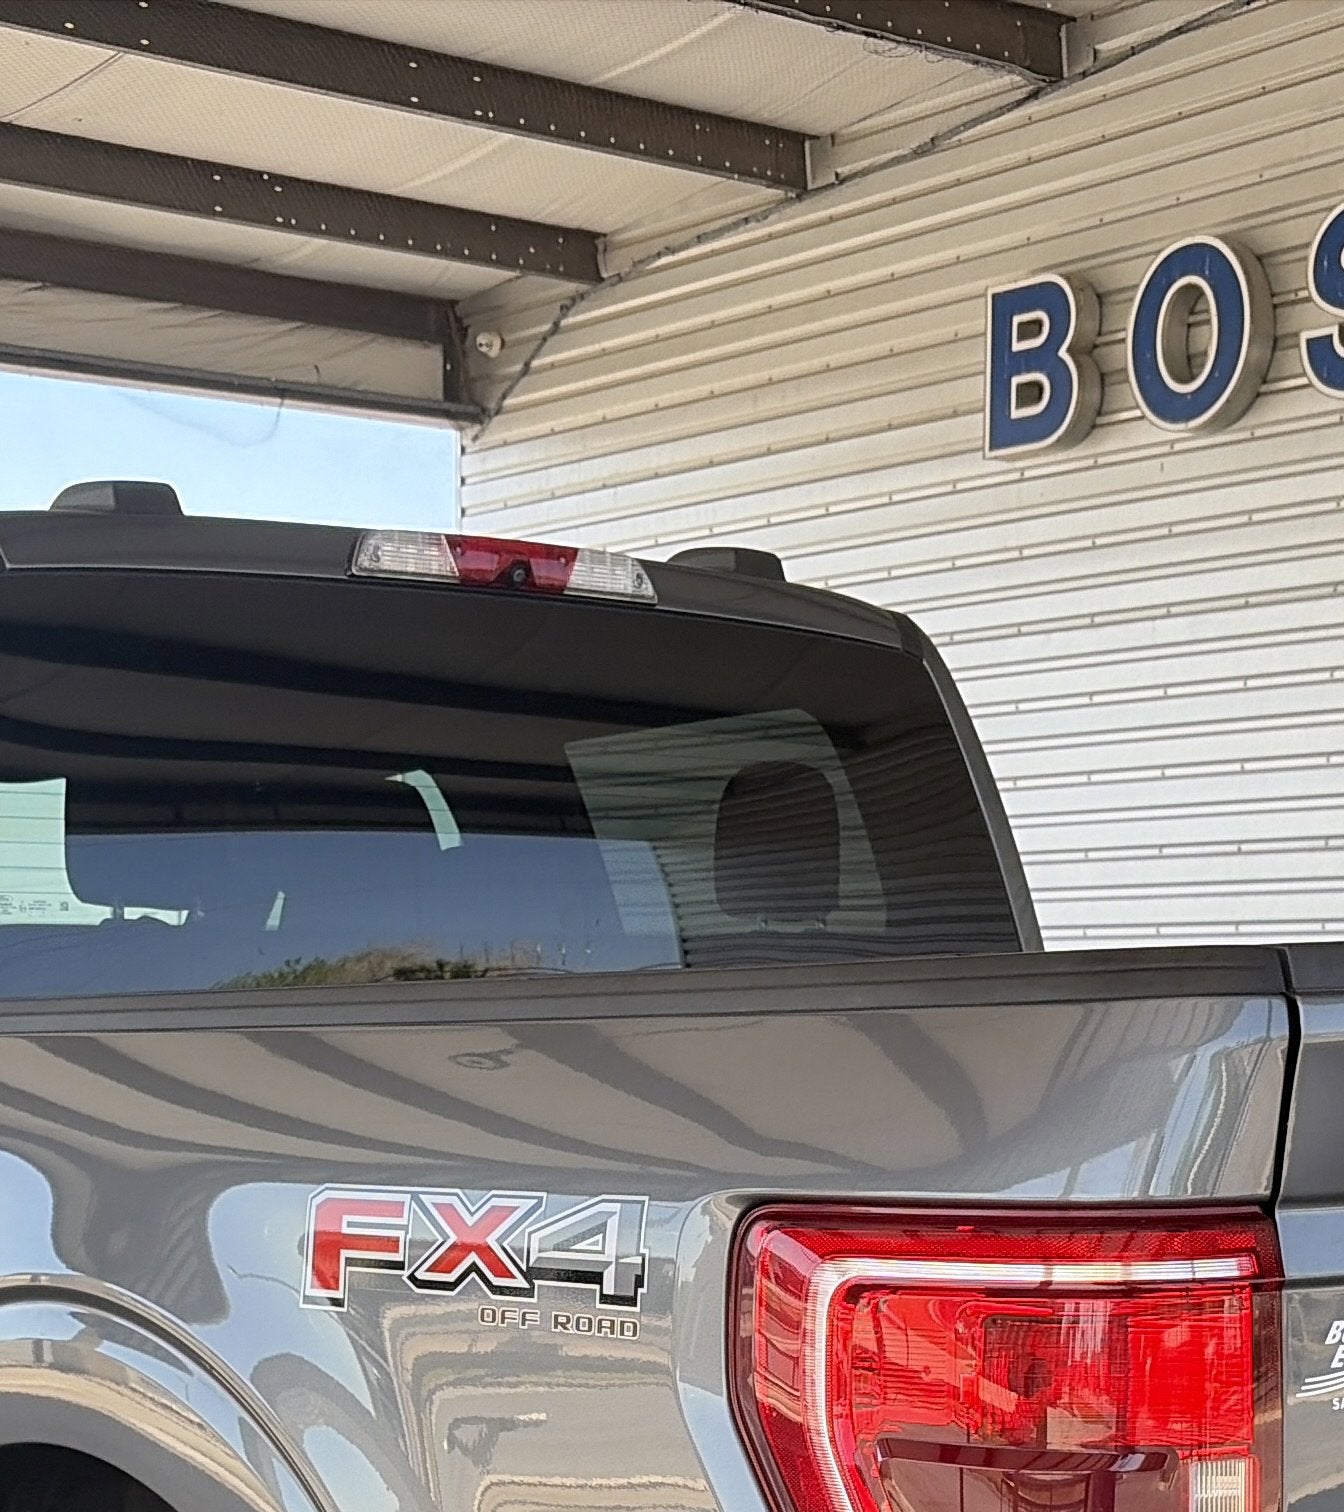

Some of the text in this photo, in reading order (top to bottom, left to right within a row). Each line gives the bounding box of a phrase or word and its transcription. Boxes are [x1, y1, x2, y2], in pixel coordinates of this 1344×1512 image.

[299, 1183, 649, 1312] FX4
[478, 1305, 640, 1340] OFF ROAD
